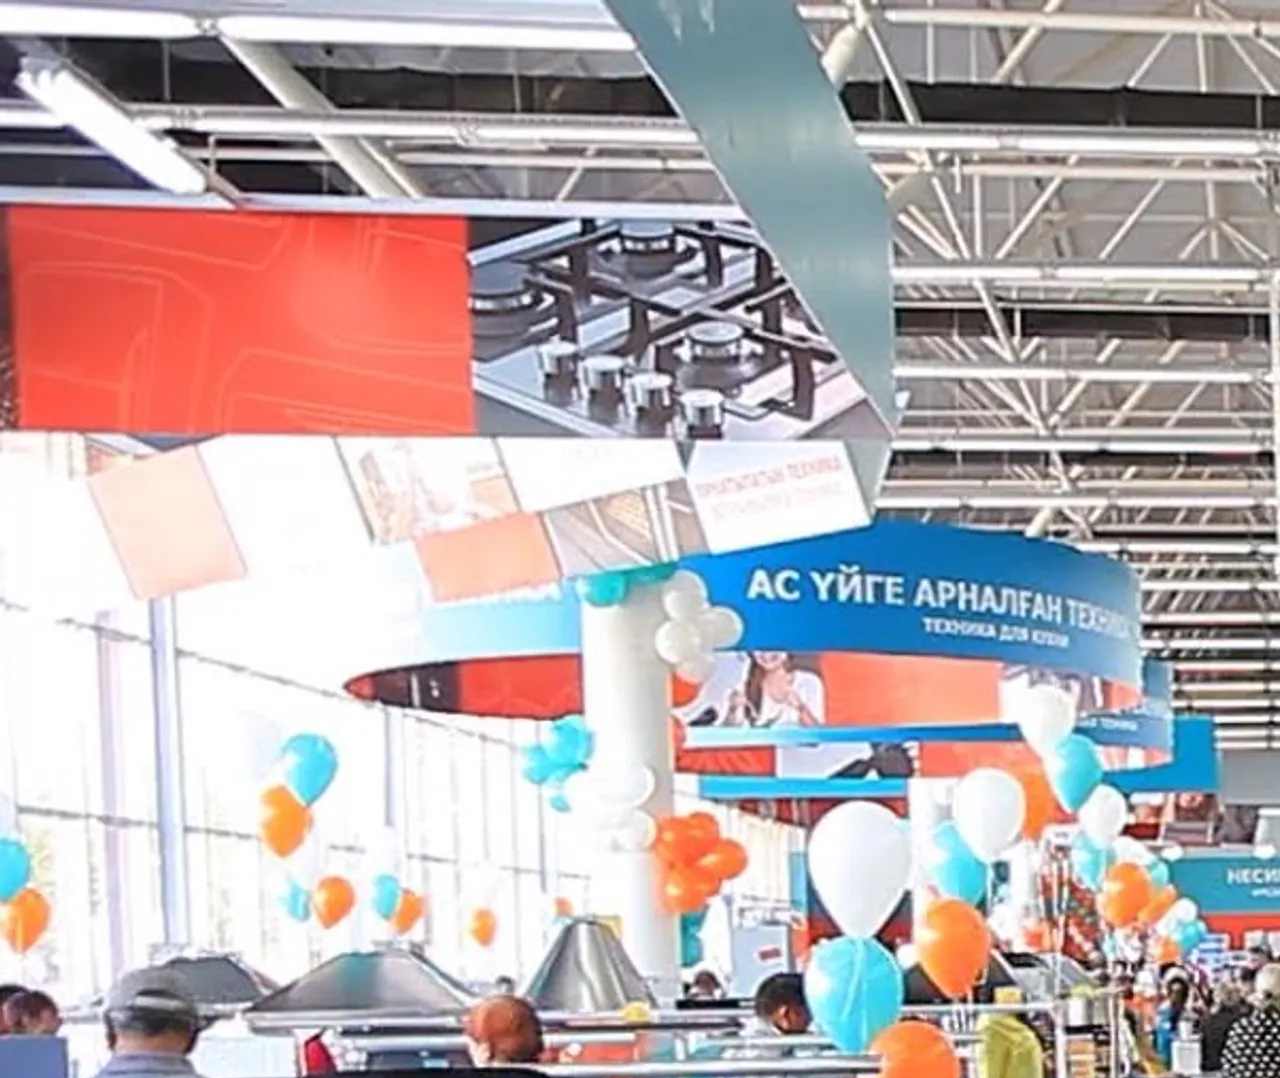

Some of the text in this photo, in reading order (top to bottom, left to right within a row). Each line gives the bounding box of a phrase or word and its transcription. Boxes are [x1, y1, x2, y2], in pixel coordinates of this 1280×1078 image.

[747, 568, 801, 600] АС
[921, 616, 997, 638] ТЕХНИКА
[999, 624, 1029, 641] ДЛЯ
